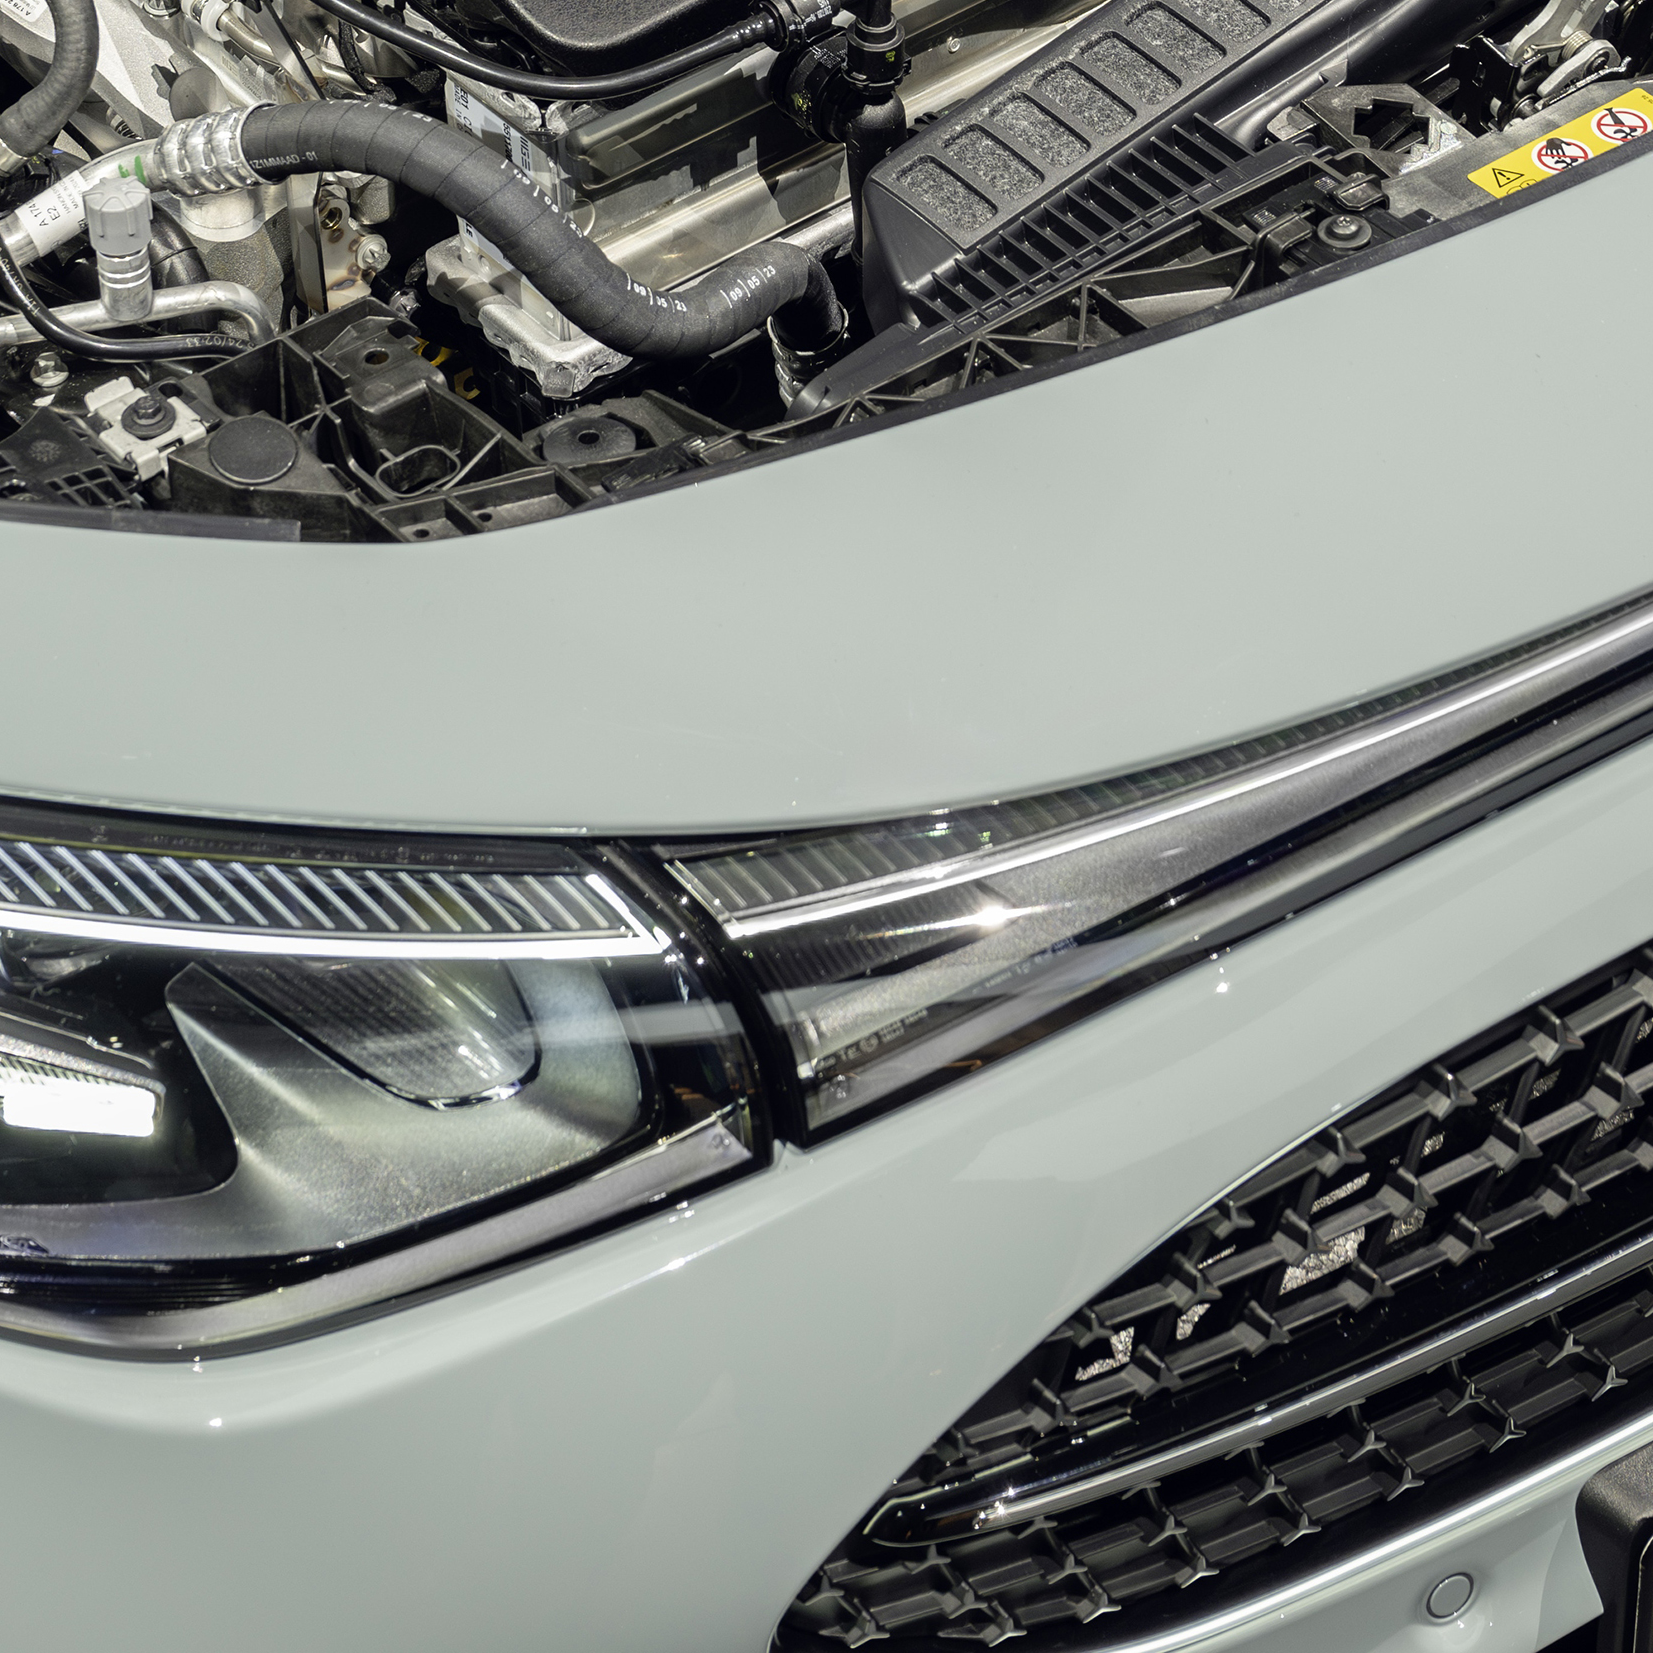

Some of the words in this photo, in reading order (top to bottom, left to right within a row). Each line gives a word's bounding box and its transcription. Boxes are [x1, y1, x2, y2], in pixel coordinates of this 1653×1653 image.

[12, 2, 25, 12] 178
[66, 195, 79, 210] MADE
[47, 205, 61, 222] E2
[39, 220, 49, 228] A
[730, 287, 743, 302] 09
[747, 276, 761, 290] 05
[763, 265, 777, 279] 23
